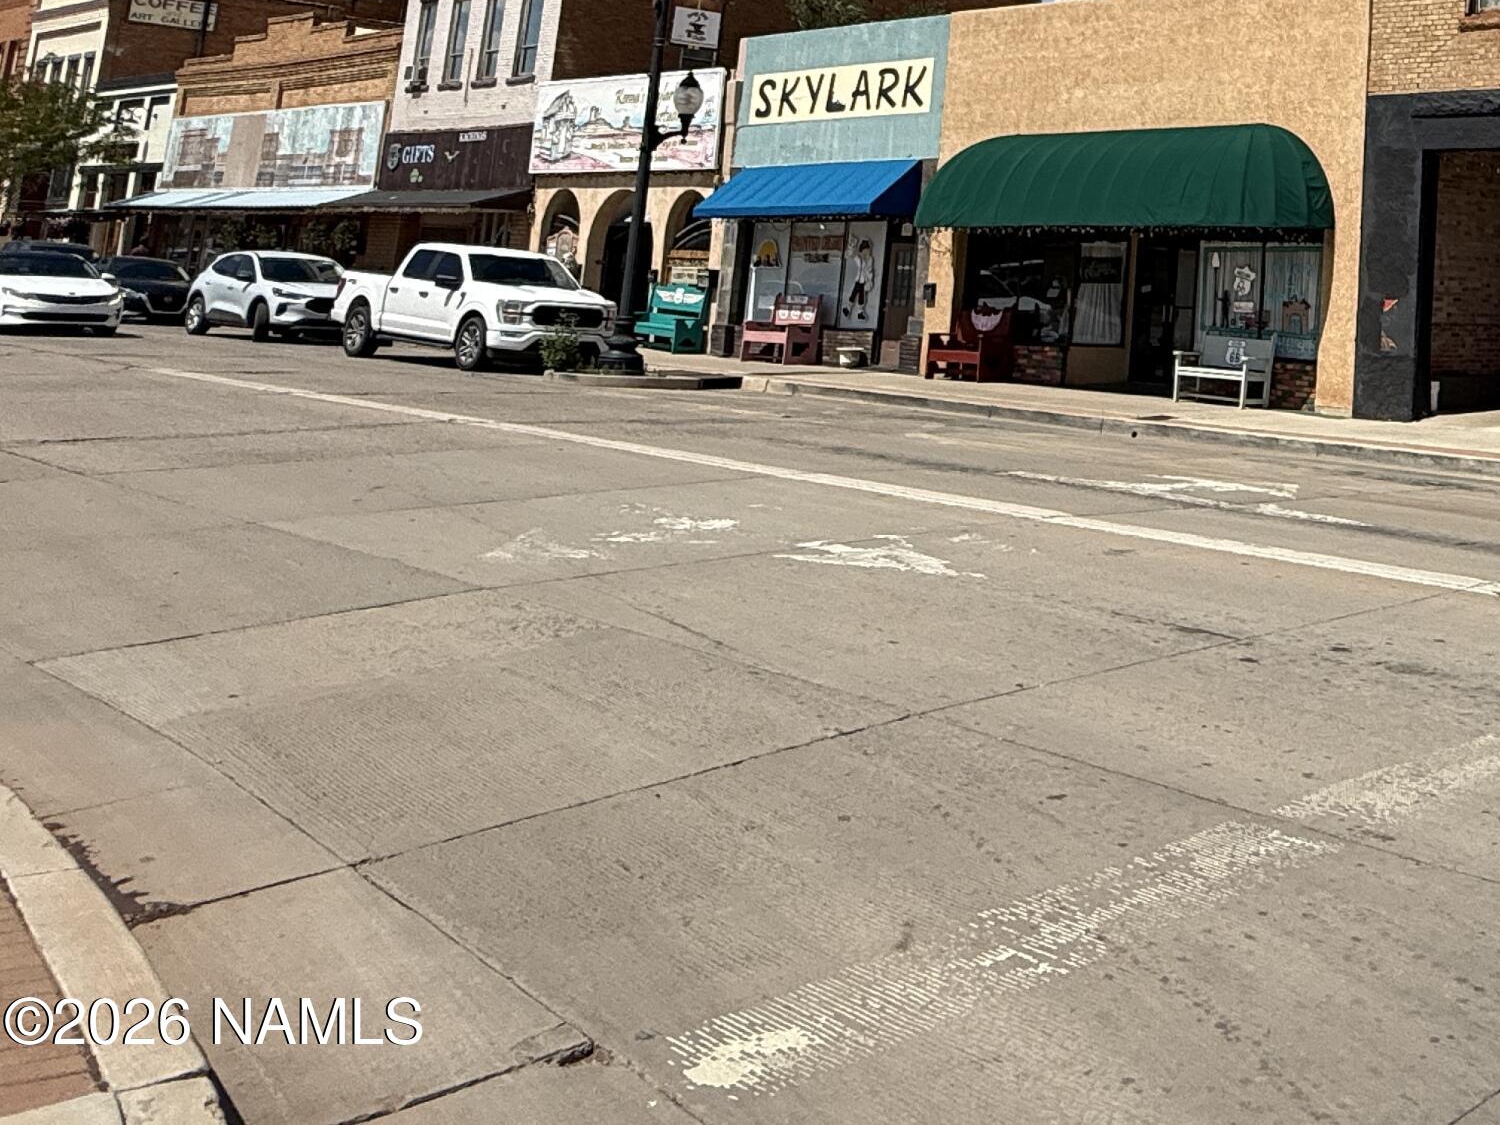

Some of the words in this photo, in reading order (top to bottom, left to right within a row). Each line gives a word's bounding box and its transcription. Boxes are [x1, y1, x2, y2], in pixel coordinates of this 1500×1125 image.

[131, 12, 154, 21] ART
[755, 66, 927, 118] SKYLARK
[402, 144, 435, 164] GIFTS
